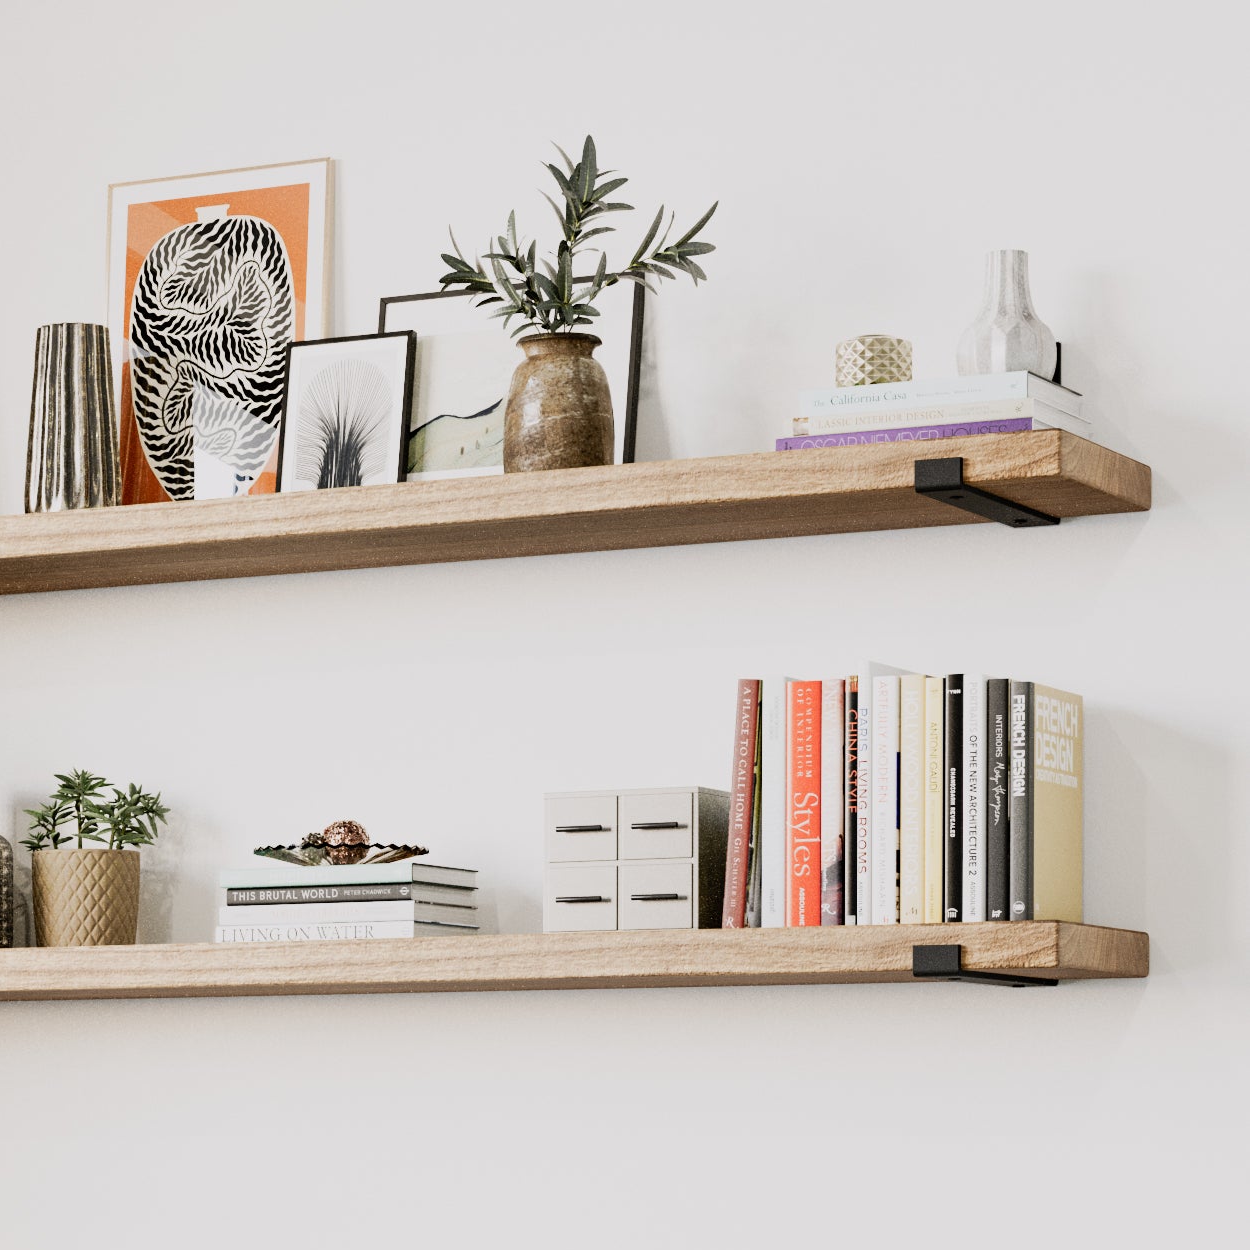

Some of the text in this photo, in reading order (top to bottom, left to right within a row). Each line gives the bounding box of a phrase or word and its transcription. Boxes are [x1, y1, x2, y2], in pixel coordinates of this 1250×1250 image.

[830, 392, 881, 406] California
[882, 391, 907, 401] Casa
[854, 412, 904, 425] INTERIOR
[906, 409, 945, 421] DESIGN
[797, 688, 804, 705] OF
[969, 684, 978, 735] PORTRAITS
[1035, 695, 1079, 738] FRENCH
[878, 681, 888, 805] ARTFULLY MODERN
[929, 722, 938, 759] ANTONI
[969, 735, 978, 750] OF
[995, 714, 1003, 758] INTERIORS
[1012, 694, 1025, 797] FRENCH DESIGN
[1035, 731, 1073, 773] DESIGN
[734, 687, 751, 831] A PLACE TO CALL HOME
[847, 709, 858, 813] CHINA STYLE
[969, 752, 978, 769] THE
[858, 707, 868, 875] PARIS LIVING ROOMS
[904, 690, 919, 896] HOLLYWOOD INTERIORS
[969, 771, 978, 793] NEW
[788, 792, 821, 877] Styles
[969, 795, 978, 867] ARCHITECTURE
[232, 887, 339, 903] THIS BRUTAL WORLD
[362, 888, 391, 896] CHADWICK
[221, 925, 375, 943] LIVING ON WATER
